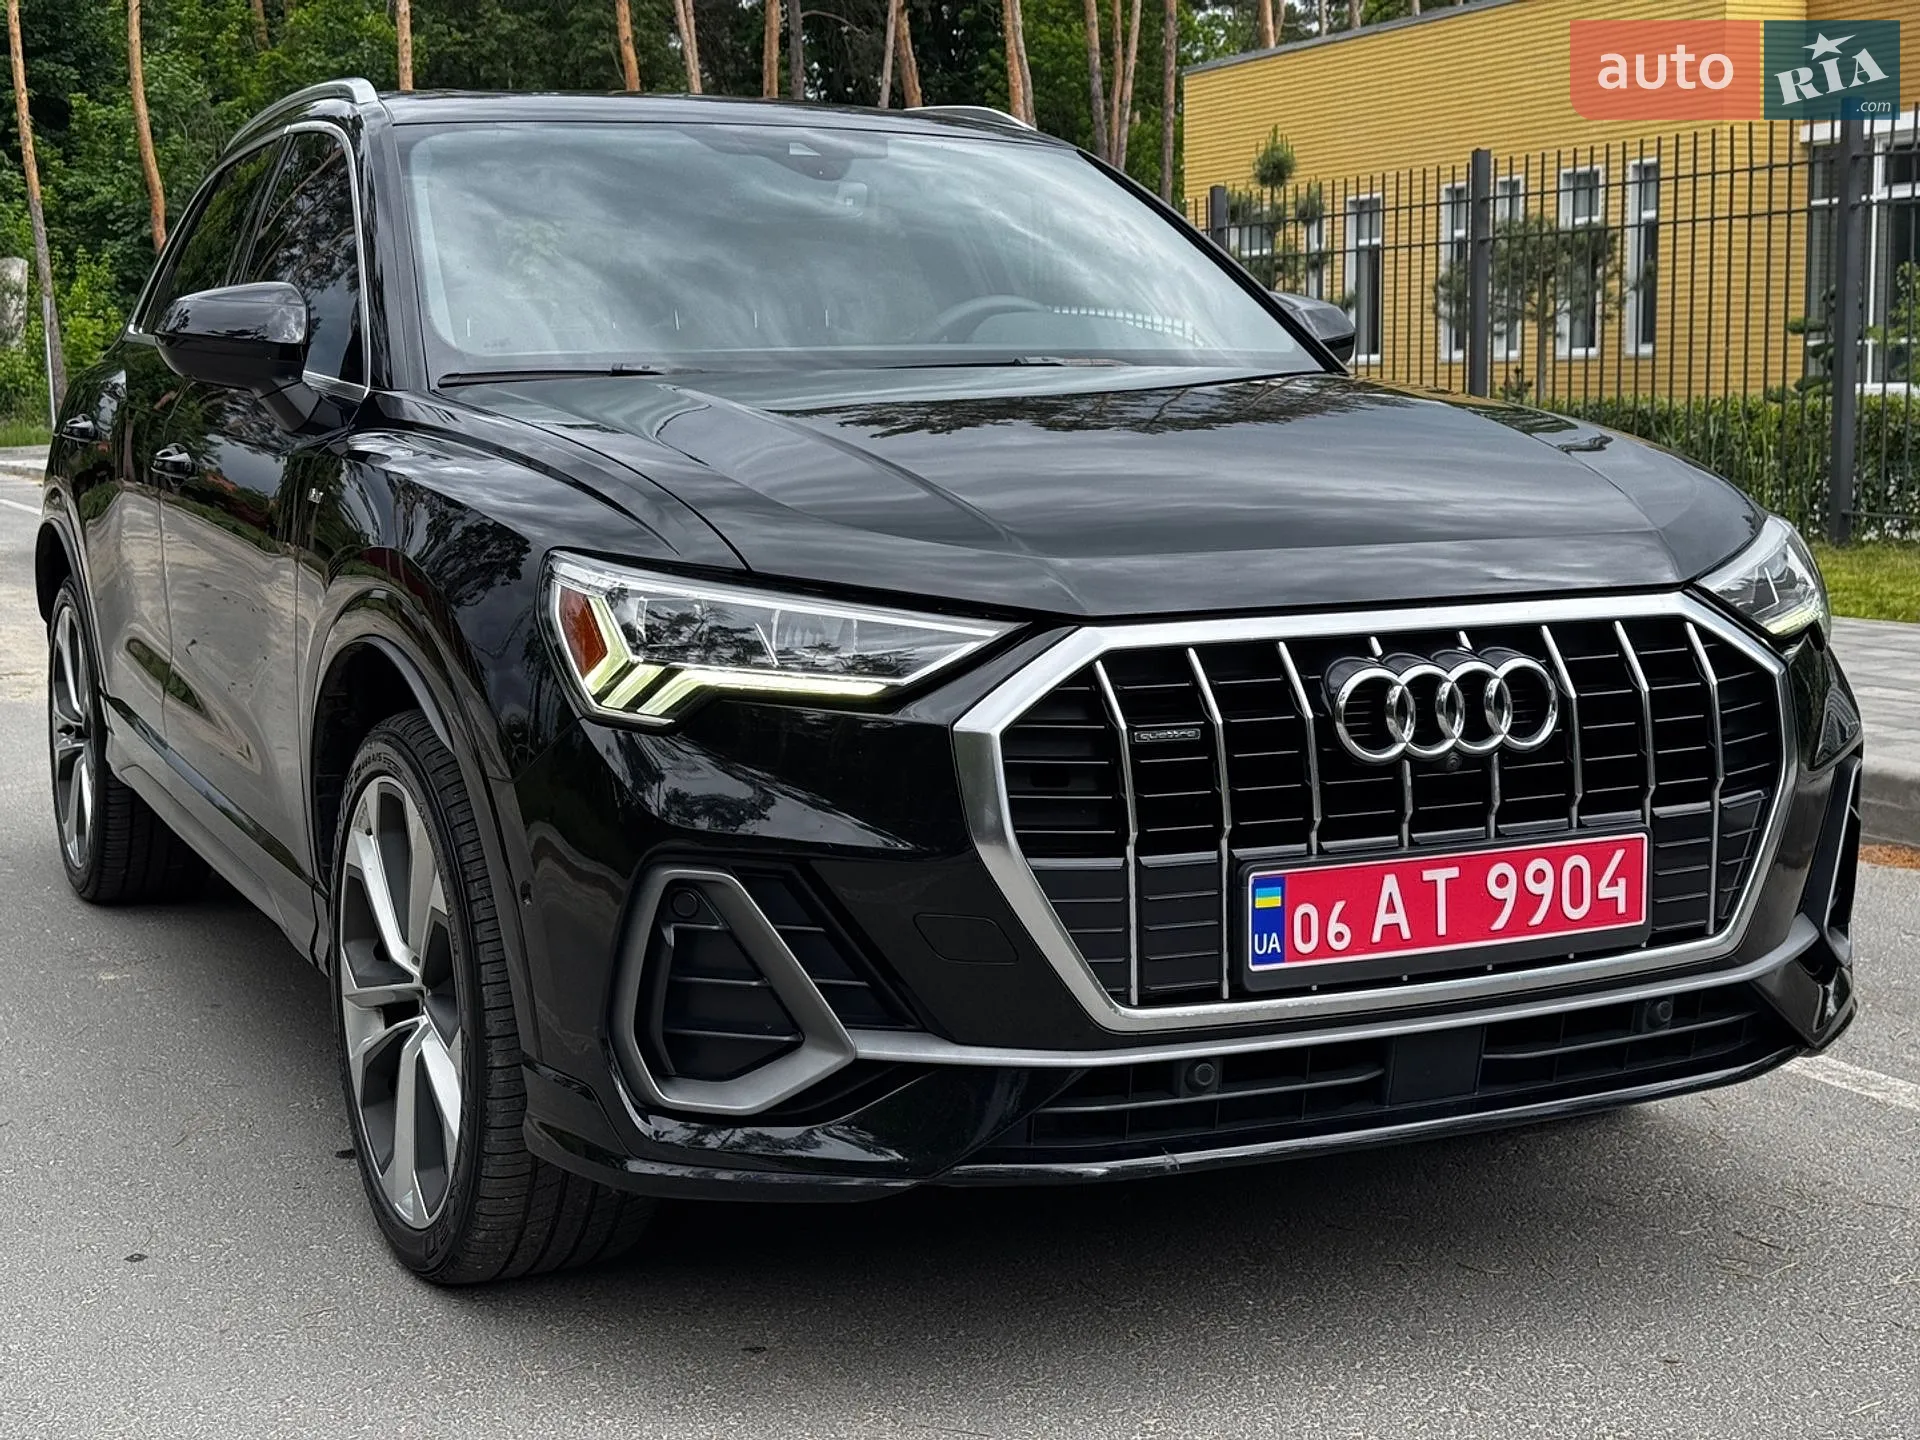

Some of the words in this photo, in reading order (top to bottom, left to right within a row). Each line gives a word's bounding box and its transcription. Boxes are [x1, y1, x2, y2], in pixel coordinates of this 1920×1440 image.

[1140, 730, 1197, 742] quattro
[1293, 900, 1352, 954] 06
[1371, 866, 1460, 943] AT
[1486, 848, 1627, 931] 9904
[1254, 932, 1281, 954] UA
